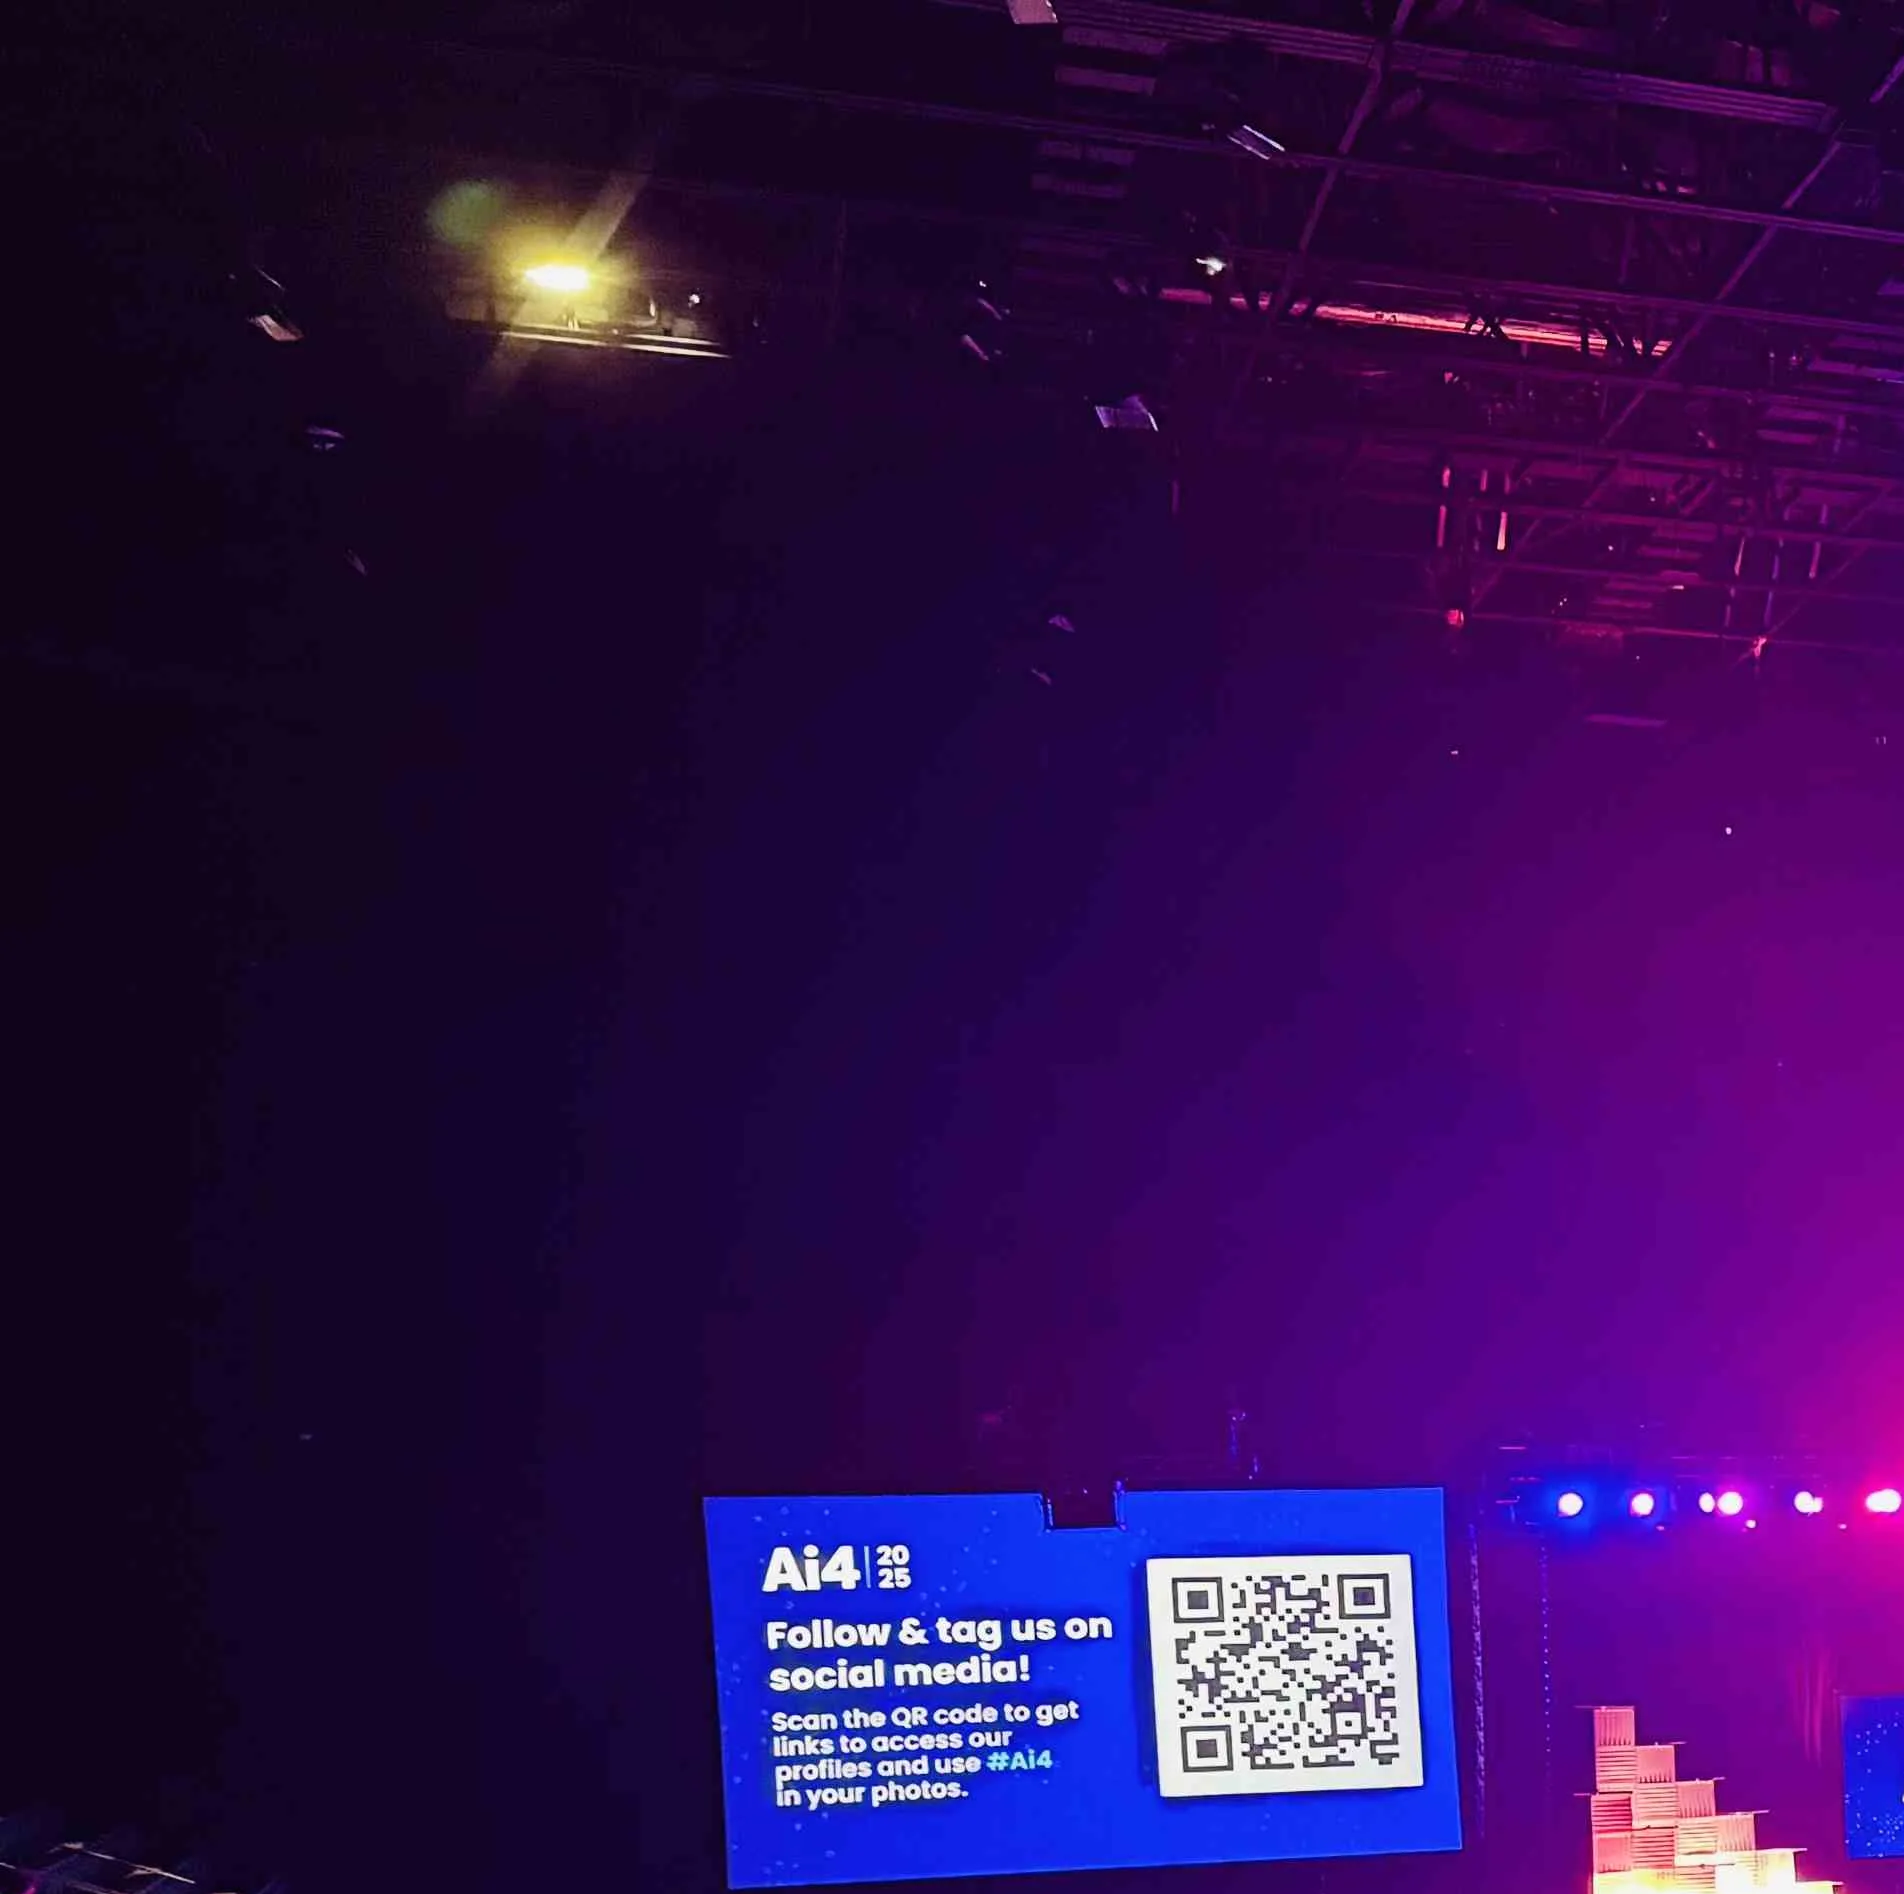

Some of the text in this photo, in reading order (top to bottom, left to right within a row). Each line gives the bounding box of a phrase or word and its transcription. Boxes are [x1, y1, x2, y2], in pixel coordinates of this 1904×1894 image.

[762, 1544, 861, 1592] Ai4
[876, 1544, 910, 1566] 20
[878, 1567, 912, 1589] 25
[766, 1616, 1113, 1651] Follow & tag us on
[769, 1654, 1030, 1692] social media!
[771, 1700, 1079, 1732] Scan the QR code to get
[773, 1730, 1013, 1757] links to access our
[775, 1750, 1053, 1785] profiles and use #Ai4
[775, 1780, 969, 1811] in your photos.
